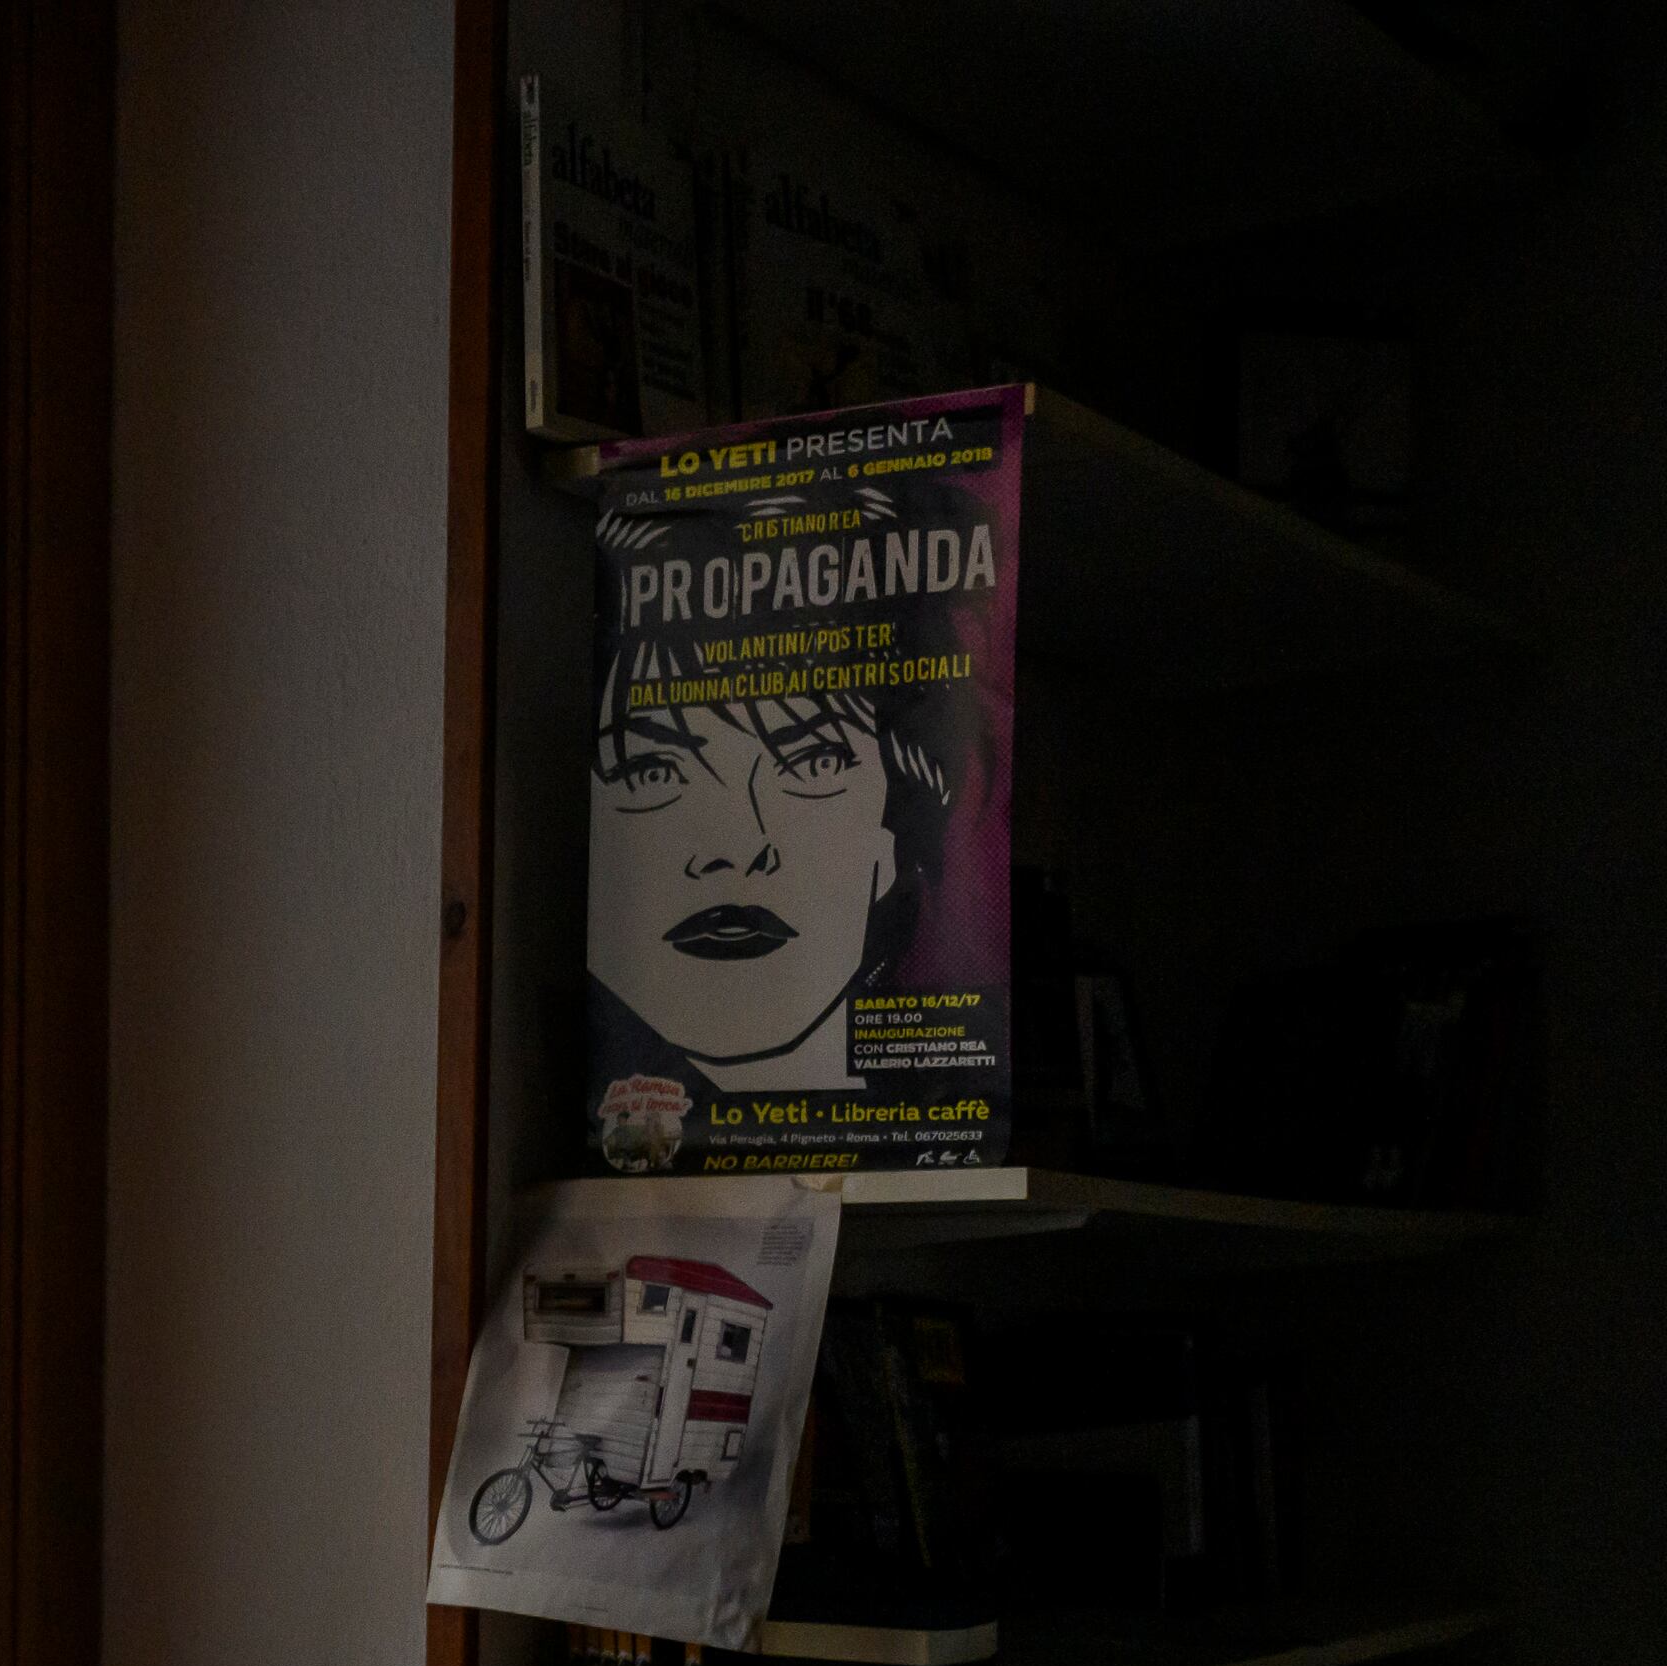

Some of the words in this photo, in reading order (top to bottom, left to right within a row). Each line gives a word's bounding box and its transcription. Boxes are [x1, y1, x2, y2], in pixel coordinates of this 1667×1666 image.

[659, 452, 701, 477] LO
[708, 438, 778, 473] YETI
[786, 416, 954, 461] PRESENTA
[626, 491, 659, 506] DAL
[685, 475, 772, 500] DICEMBRE
[775, 469, 816, 486] 2017
[819, 468, 843, 482] AL
[847, 463, 860, 478] 6
[862, 453, 947, 477] GENNAIO
[950, 447, 994, 466] 2018
[629, 524, 995, 628] PROPAGANDA
[630, 682, 666, 707] DAL
[734, 671, 785, 698] CLUB
[786, 669, 808, 693] AI
[813, 661, 887, 690] CENTRI
[888, 654, 972, 684] SOCIALI
[855, 995, 918, 1010] SABATO
[922, 993, 982, 1008] 16/12/17
[854, 1014, 883, 1025] ORE
[887, 1012, 923, 1024] 19.00
[855, 1025, 965, 1040] INAUGURAZIONE
[854, 1044, 883, 1055] CON
[886, 1042, 958, 1054] CRISTIANO
[959, 1040, 987, 1051] REA
[854, 1058, 912, 1069] VALERIO
[914, 1056, 995, 1067] LAZZARETTI
[710, 1103, 743, 1126] Lo
[752, 1099, 808, 1124] Yeti
[831, 1101, 921, 1124] Libreria
[928, 1099, 991, 1121] caffè
[708, 1135, 727, 1144] Via
[729, 1133, 777, 1145] Perugia,
[779, 1133, 788, 1143] 4
[790, 1133, 836, 1145] Pigneto
[846, 1132, 879, 1143] Roma
[914, 1130, 983, 1141] 067025633
[704, 1153, 735, 1170] NO
[743, 1153, 859, 1169] BARRIERE!
